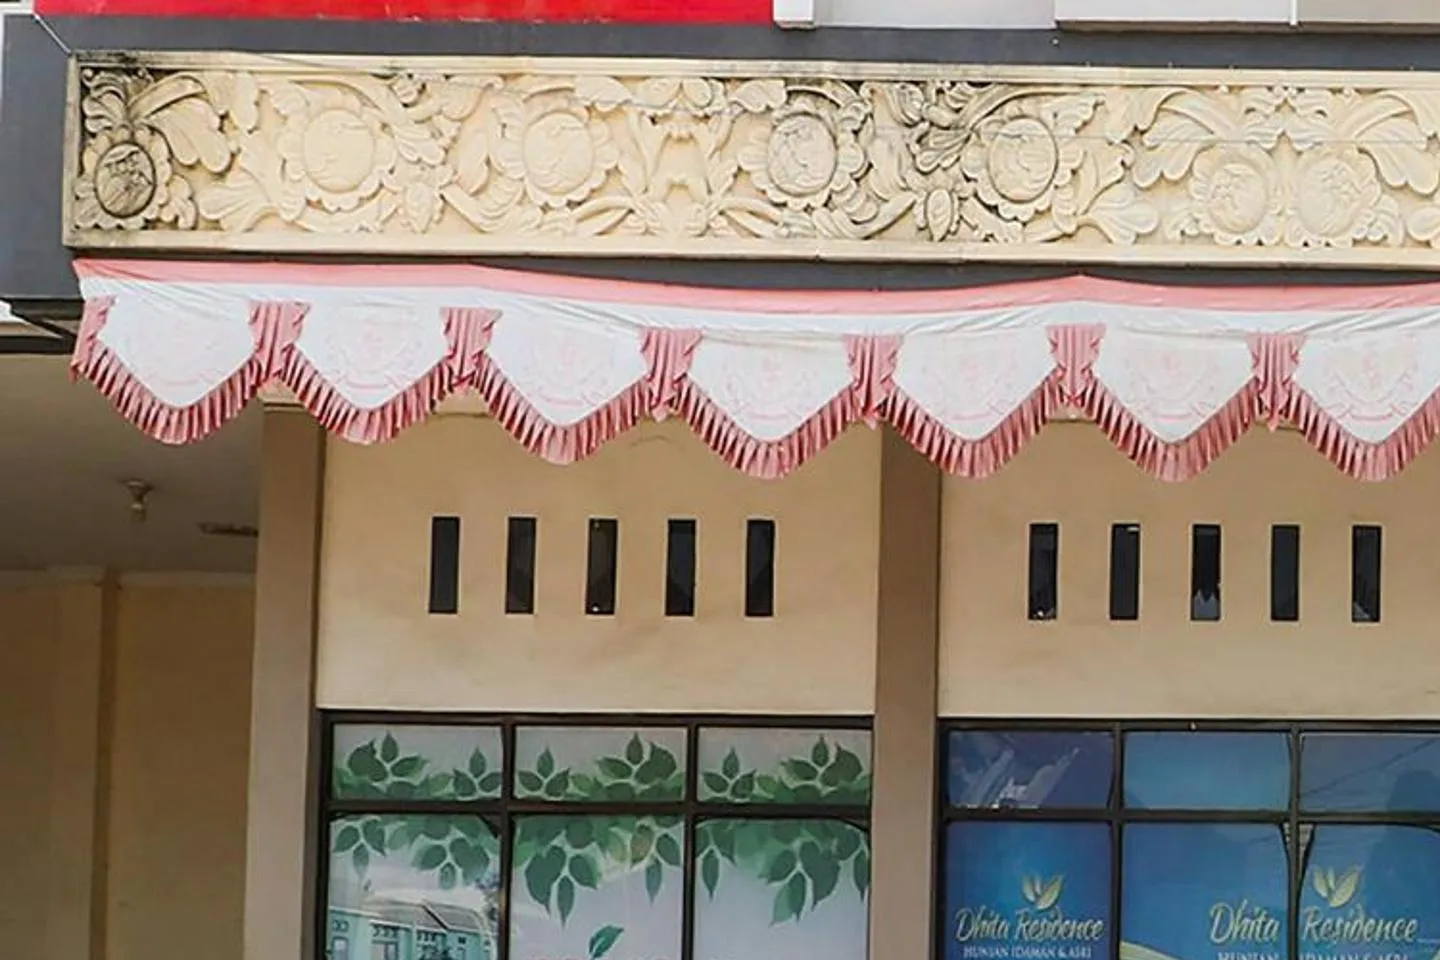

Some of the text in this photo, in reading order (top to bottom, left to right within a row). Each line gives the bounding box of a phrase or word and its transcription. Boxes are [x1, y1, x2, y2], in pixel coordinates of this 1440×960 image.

[956, 905, 1104, 941] Dhita Residence
[1209, 898, 1418, 945] Dhita Residence
